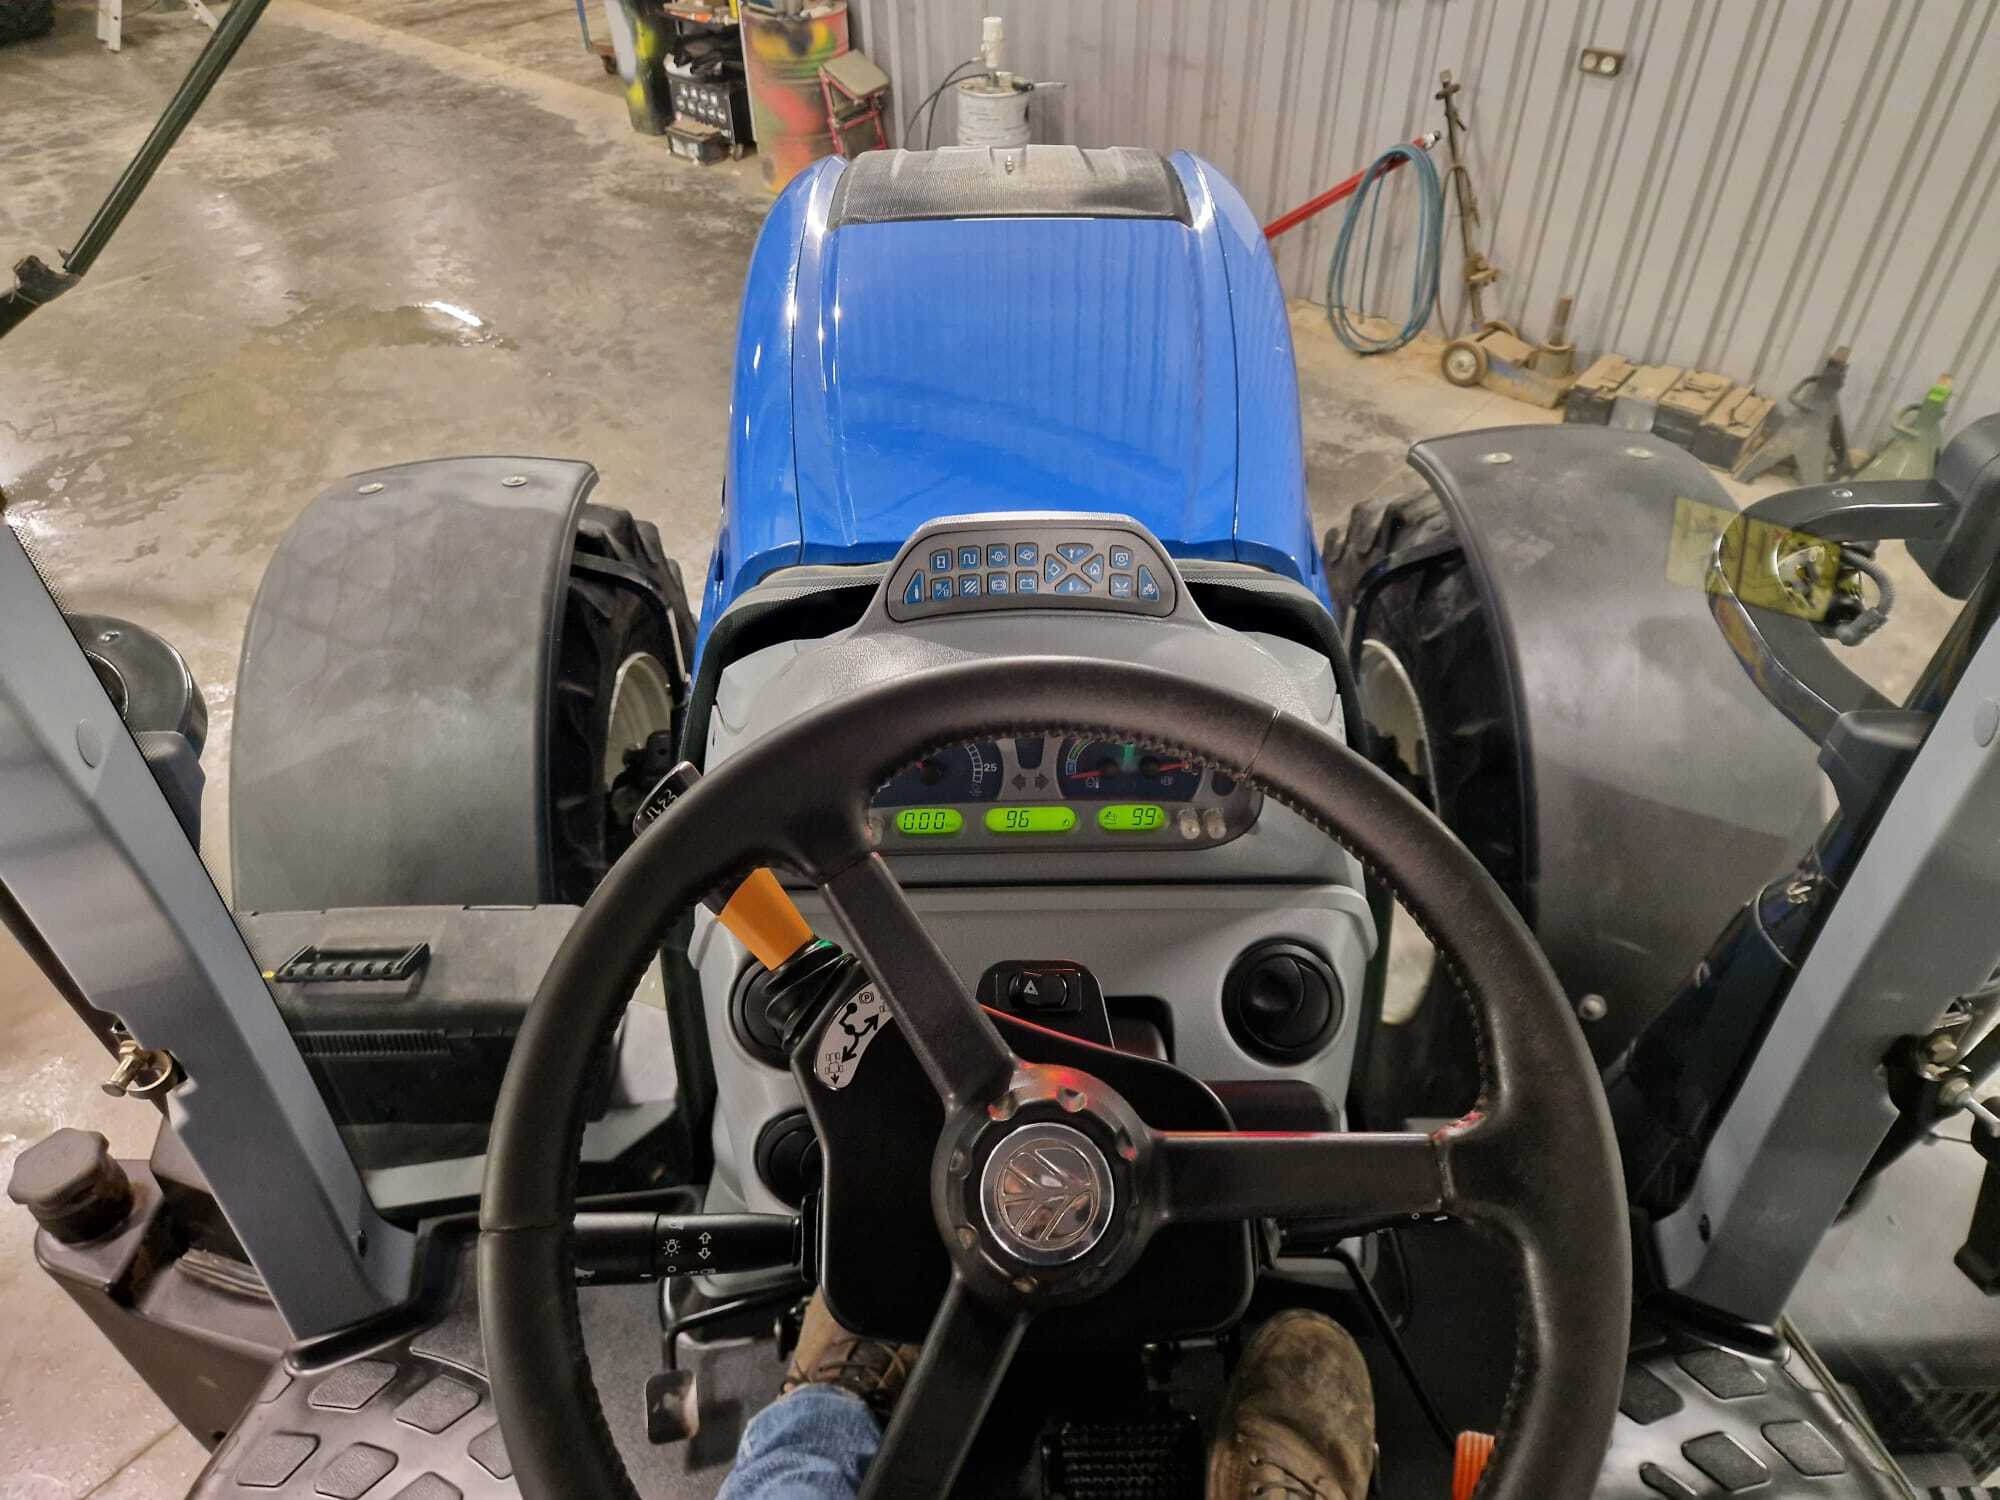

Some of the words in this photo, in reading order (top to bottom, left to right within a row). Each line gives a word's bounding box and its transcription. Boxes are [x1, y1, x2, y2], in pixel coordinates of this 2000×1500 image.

[983, 763, 997, 773] 25
[1006, 810, 1031, 828] 96
[1132, 808, 1156, 826] 99
